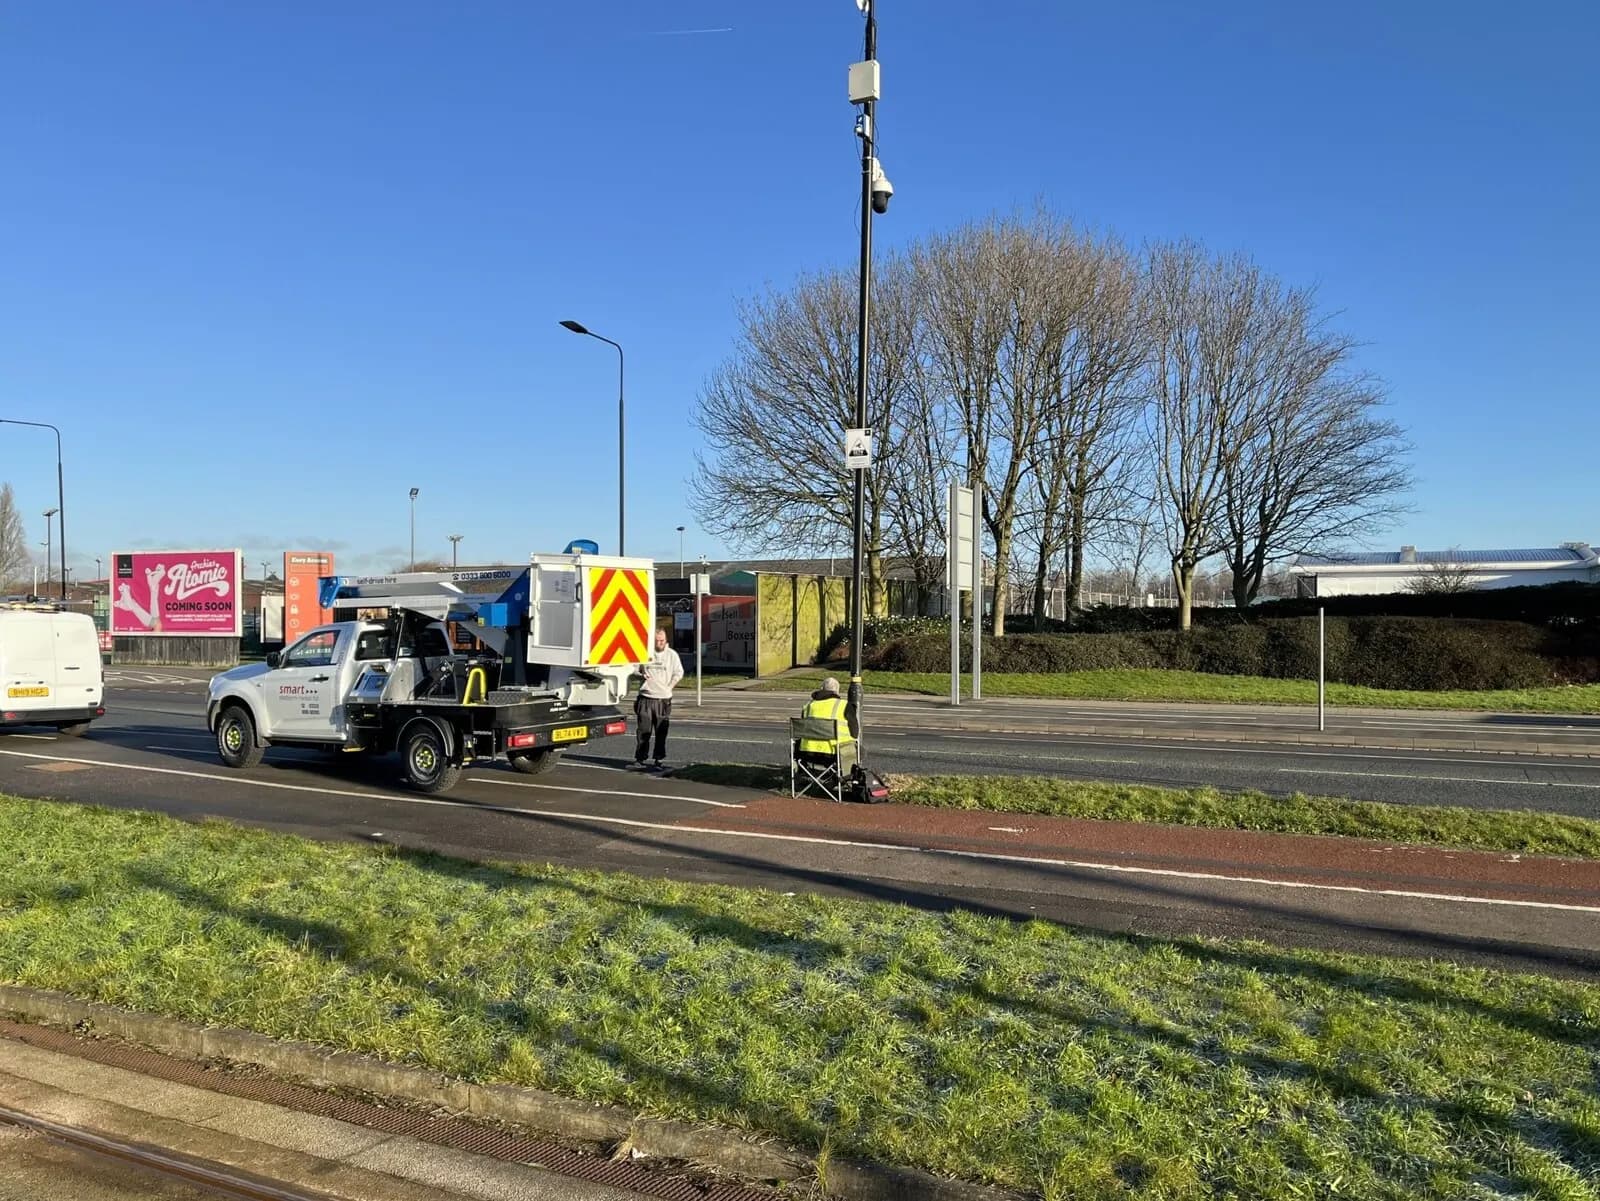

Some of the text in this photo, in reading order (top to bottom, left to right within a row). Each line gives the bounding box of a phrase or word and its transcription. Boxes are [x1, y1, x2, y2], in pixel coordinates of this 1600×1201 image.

[164, 563, 230, 600] Atomic
[385, 575, 397, 584] hire
[165, 601, 232, 611] COMING SOON
[280, 685, 305, 694] smart
